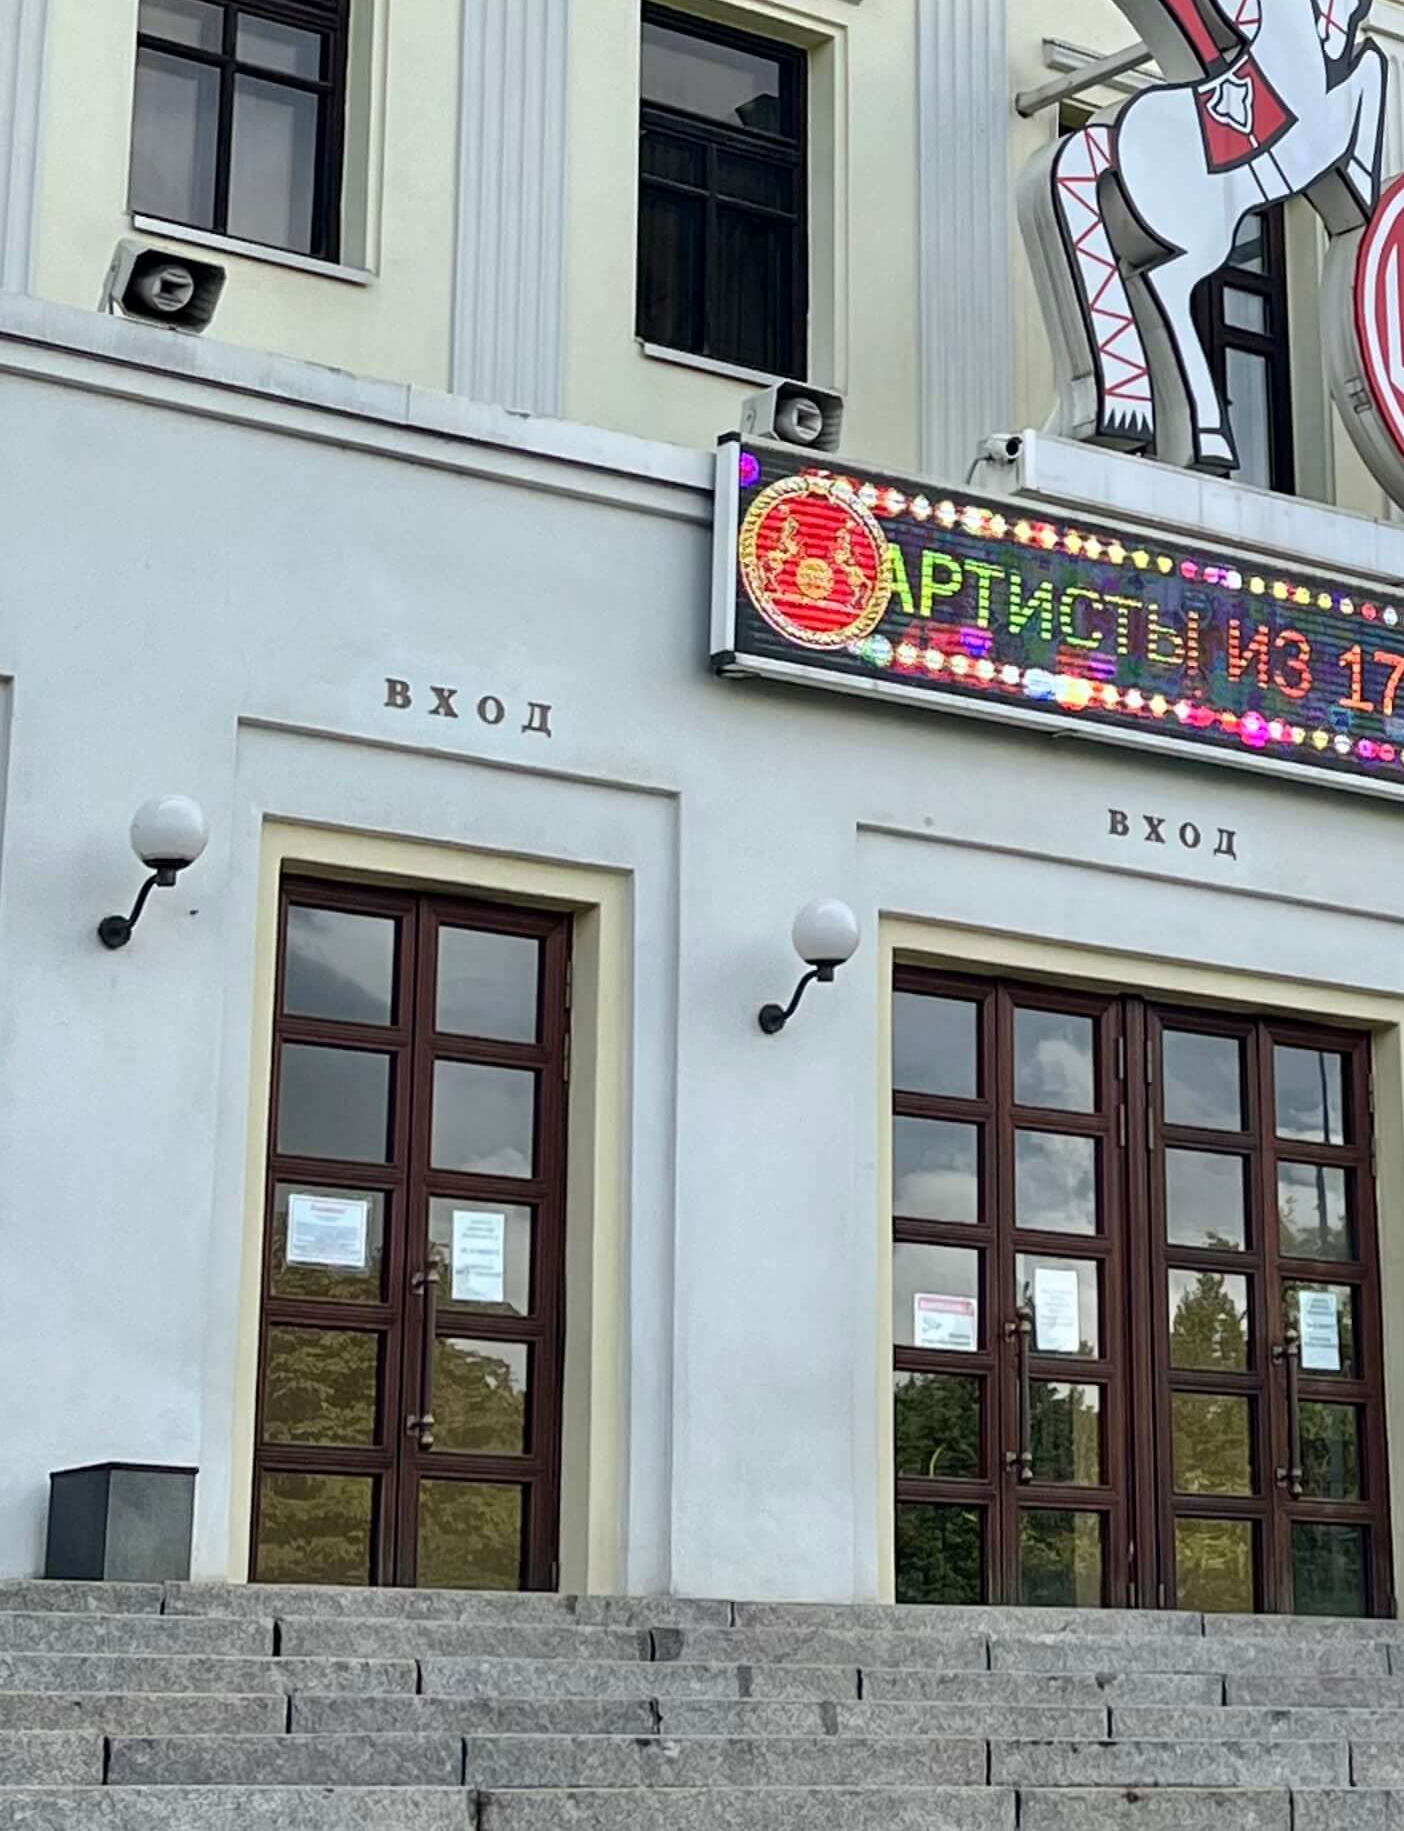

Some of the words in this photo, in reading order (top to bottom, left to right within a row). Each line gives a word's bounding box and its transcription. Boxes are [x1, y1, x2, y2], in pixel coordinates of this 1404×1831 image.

[1227, 618, 1312, 699] ИЗ
[384, 677, 552, 738] ВХОД
[1107, 808, 1237, 861] ВХОД
